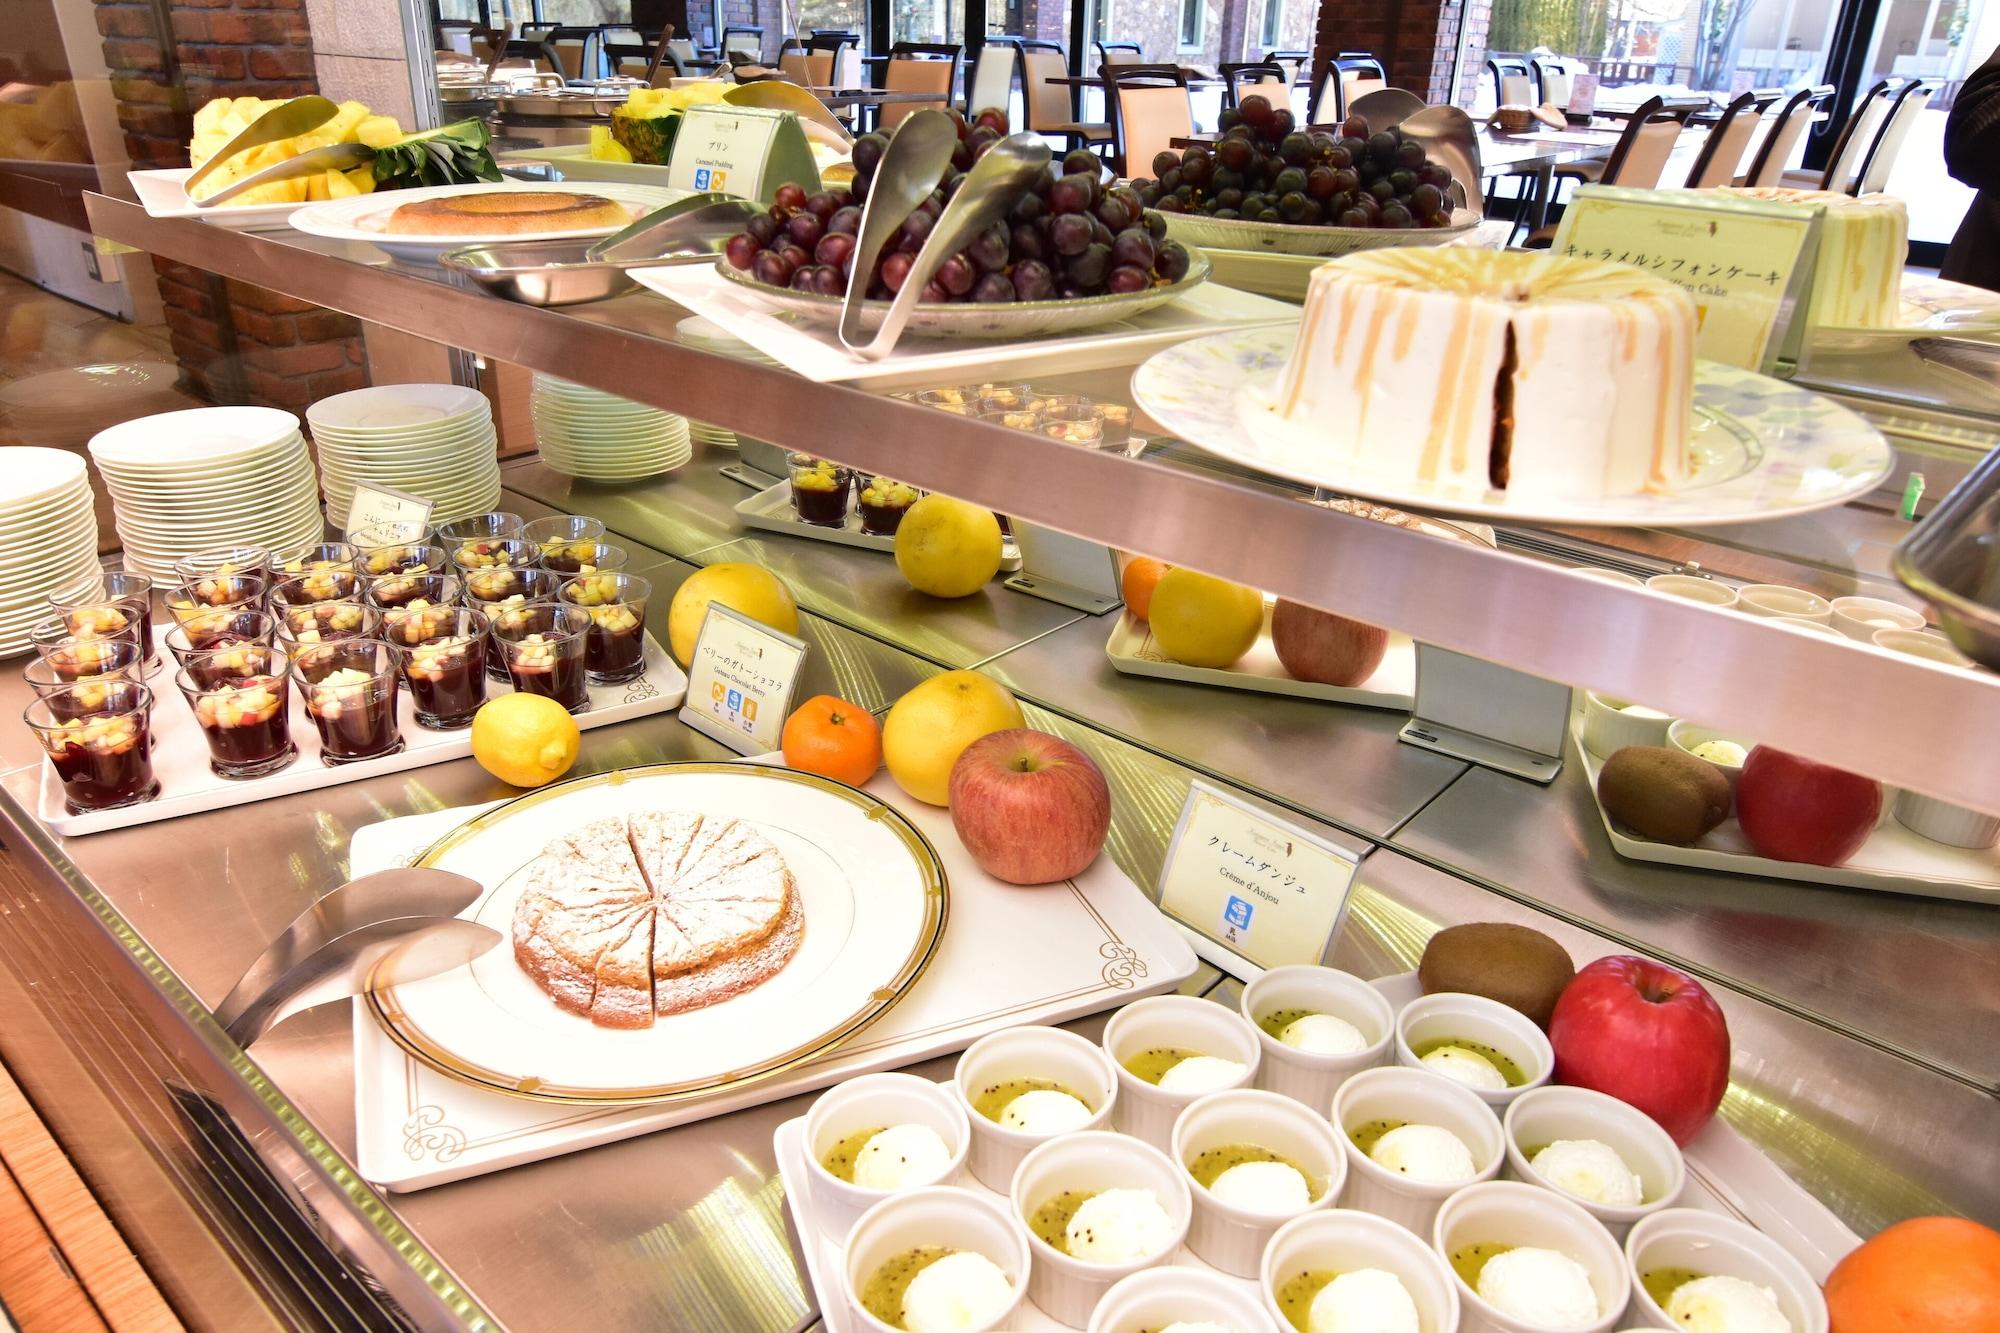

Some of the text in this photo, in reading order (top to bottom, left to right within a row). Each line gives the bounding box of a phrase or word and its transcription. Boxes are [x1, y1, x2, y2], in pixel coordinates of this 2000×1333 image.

[709, 141, 729, 152] プリン
[1565, 243, 1782, 286] キャラメルシフォンケーキ
[1698, 282, 1728, 298] Cake
[703, 647, 782, 692] ベリーのガトーショコラ
[752, 685, 766, 697] Berry
[1207, 836, 1307, 895] クレームダンジュ
